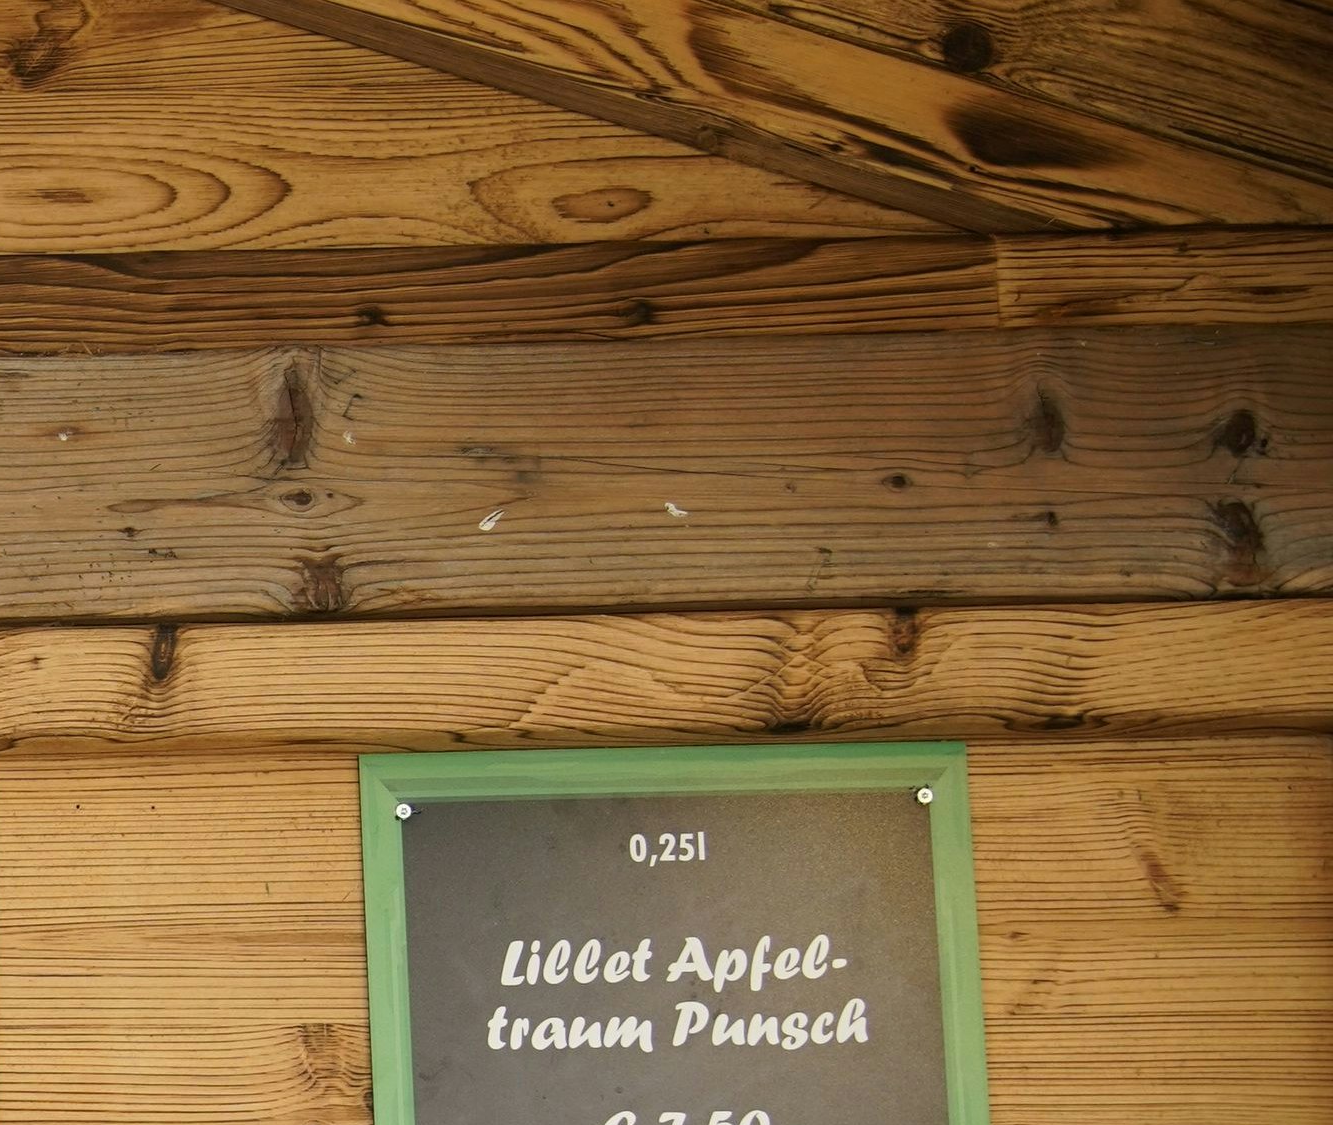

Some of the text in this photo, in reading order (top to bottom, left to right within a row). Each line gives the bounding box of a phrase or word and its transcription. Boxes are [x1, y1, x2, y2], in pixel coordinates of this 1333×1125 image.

[629, 831, 706, 867] 0,25l
[500, 934, 848, 993] Lillet Apfel-
[487, 997, 869, 1053] traum Punsch
